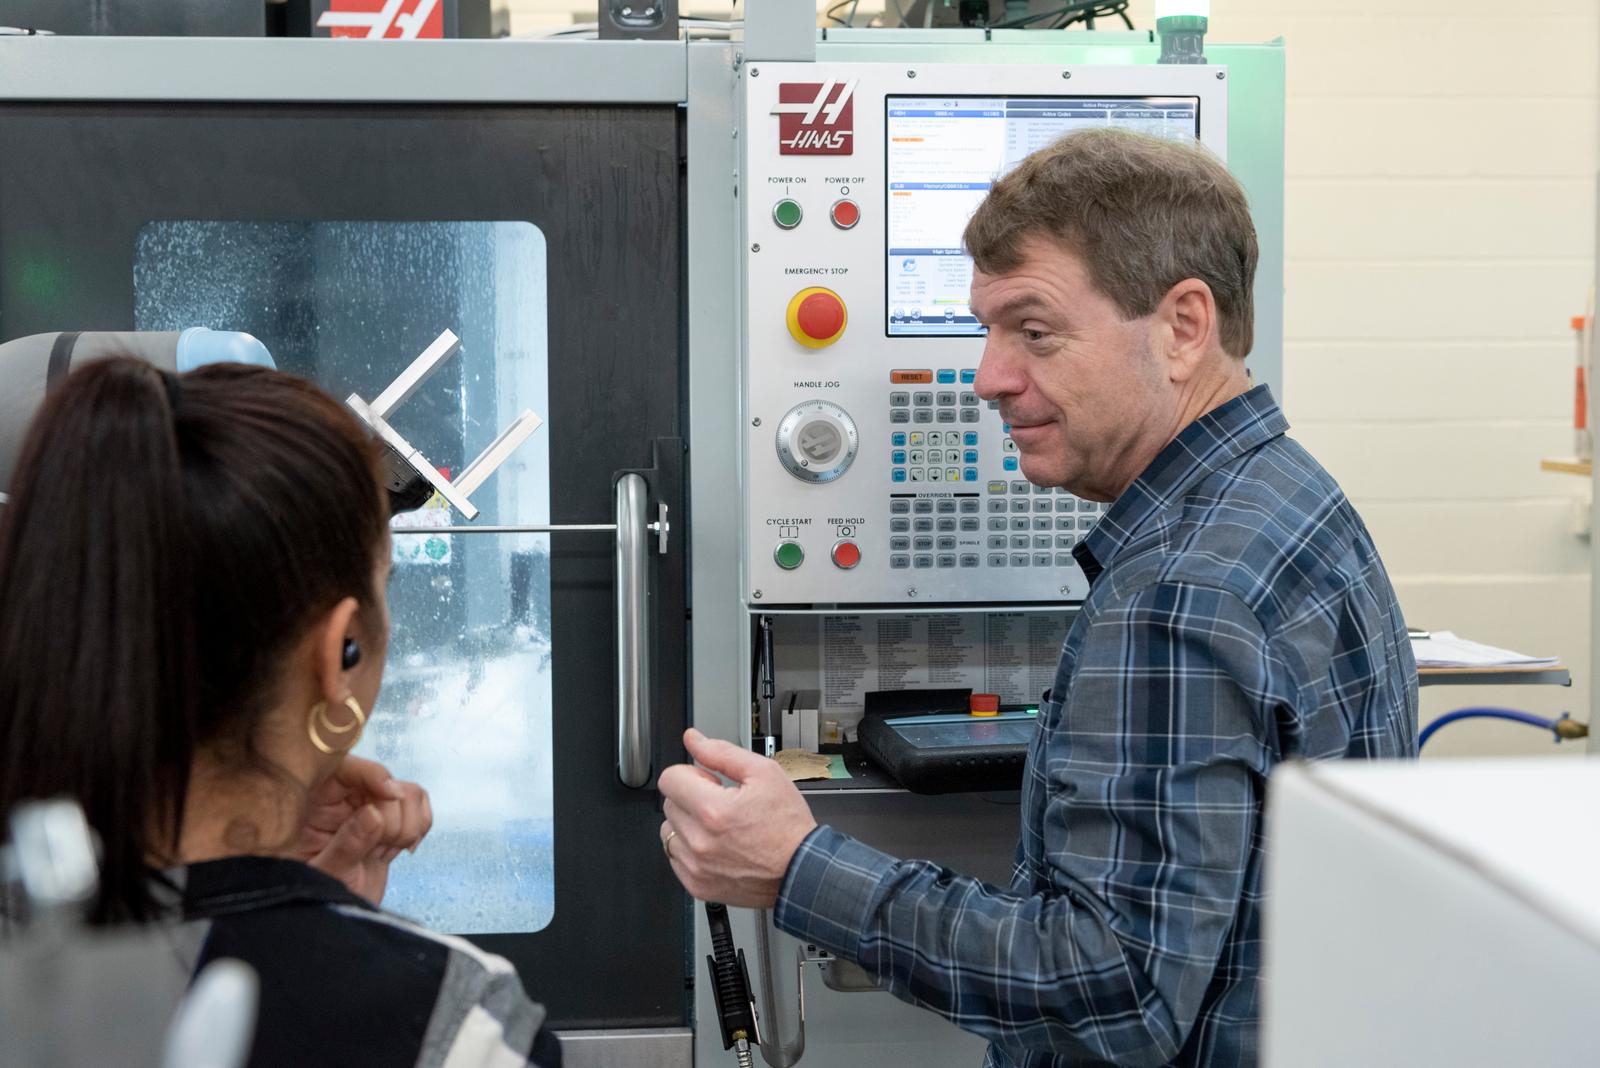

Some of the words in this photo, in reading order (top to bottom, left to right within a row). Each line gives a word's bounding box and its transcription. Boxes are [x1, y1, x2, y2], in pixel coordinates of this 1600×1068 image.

[780, 129, 854, 149] HAAS
[767, 176, 793, 184] POWER
[794, 176, 807, 184] ON
[824, 176, 850, 184] POWER
[851, 176, 865, 184] OFF
[793, 380, 823, 388] HANDLE
[823, 380, 840, 388] JOG
[766, 518, 790, 526] CYCLE
[827, 517, 844, 525] FEED
[845, 517, 866, 525] HOLD
